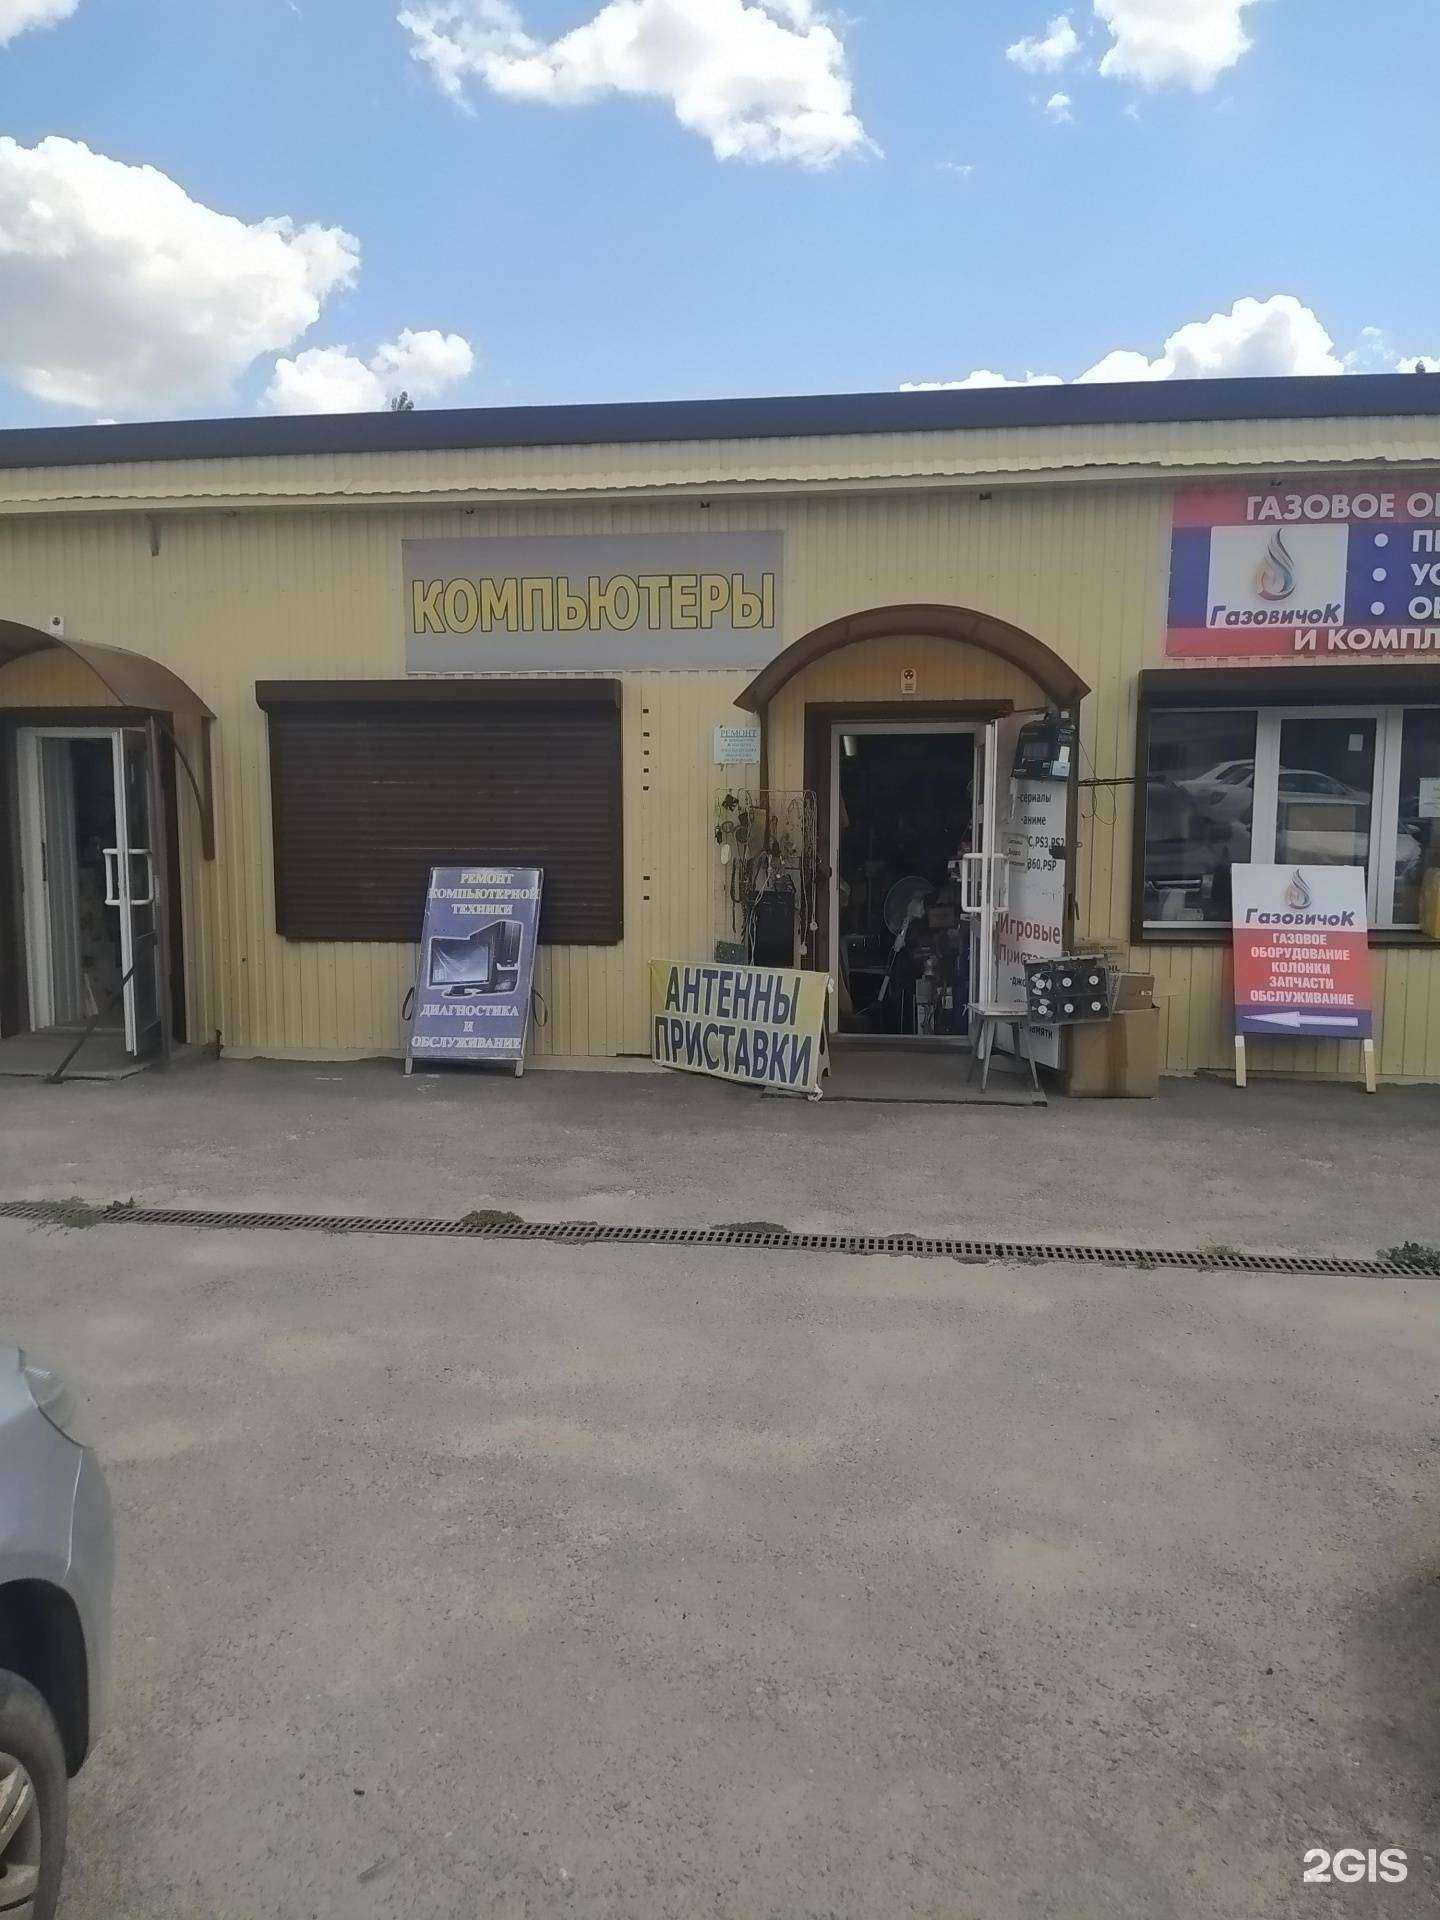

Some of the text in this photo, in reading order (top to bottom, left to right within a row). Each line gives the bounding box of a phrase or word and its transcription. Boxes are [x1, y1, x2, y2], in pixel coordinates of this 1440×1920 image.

[1246, 491, 1440, 521] ГАЗОВОЕ О
[412, 573, 775, 634] КОМПЬЮТЕРЫ
[1294, 629, 1317, 651] И
[459, 873, 515, 884] РЕМОНТ
[428, 887, 541, 900] КОМПЬЮТЕРНОЙ
[451, 904, 513, 915] ТЕХНИКИ
[998, 911, 1062, 944] Игровые
[1272, 933, 1328, 945] ГАЗОВОЕ
[1250, 946, 1350, 961] ОБОРУДОВАНИЕ
[1271, 962, 1331, 975] КОЛОНКИ
[1268, 976, 1334, 990] ЗАПЧАСТИ
[665, 966, 802, 1026] АНТЕННЫ
[1250, 989, 1355, 1006] ОБСЛУЖИВАНИЕ
[419, 1004, 520, 1017] ДИАГНОСТИКА
[463, 1021, 475, 1033] И
[410, 1036, 522, 1049] ОБСЛУЖИВАНИЕ
[654, 1016, 813, 1087] ПРИСТАВКИ
